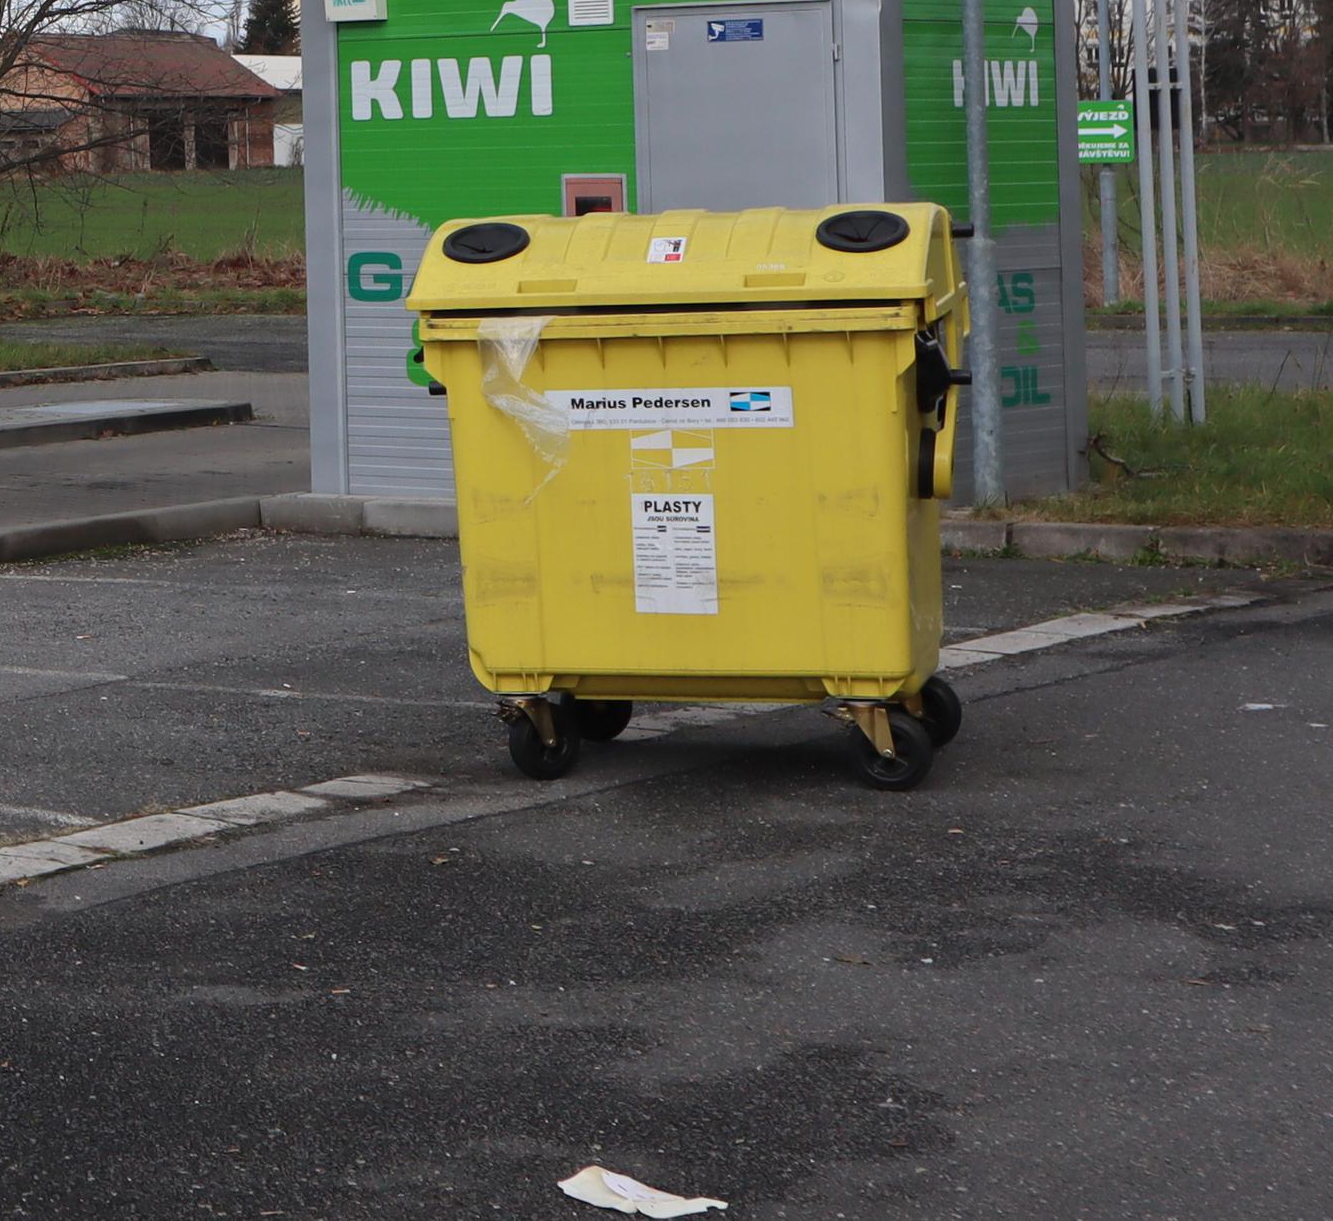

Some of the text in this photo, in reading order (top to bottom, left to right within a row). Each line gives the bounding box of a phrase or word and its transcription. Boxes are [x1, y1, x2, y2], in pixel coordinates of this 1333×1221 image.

[350, 54, 553, 121] KIWI
[570, 396, 711, 410] Marius Pedersen
[644, 500, 702, 514] PLASTY
